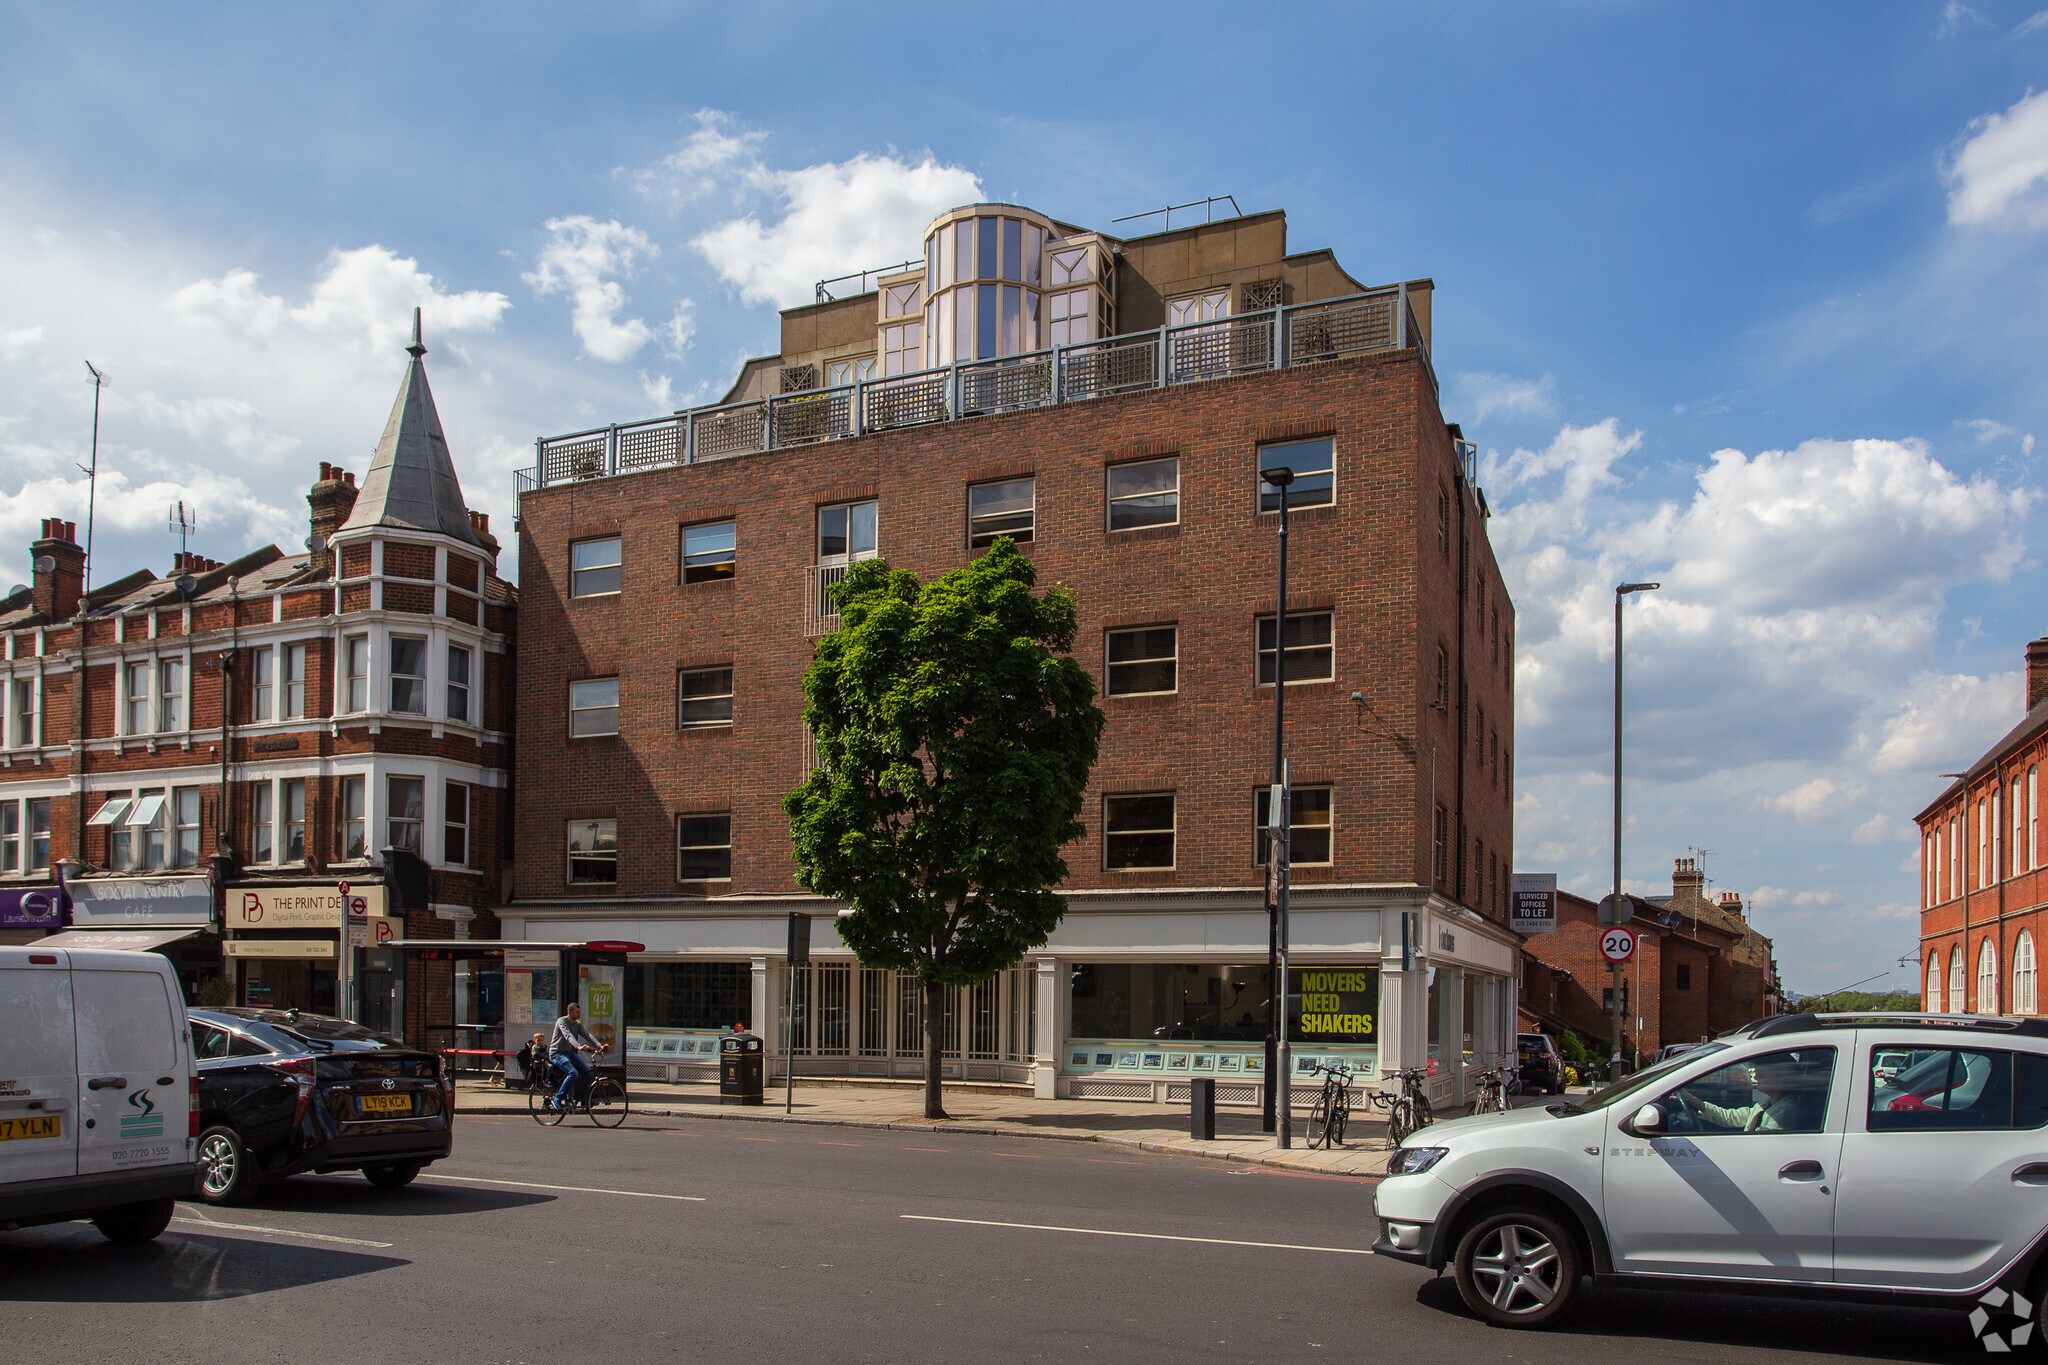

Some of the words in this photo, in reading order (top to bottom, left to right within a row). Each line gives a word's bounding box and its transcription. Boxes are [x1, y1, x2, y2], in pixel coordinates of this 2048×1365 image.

[98, 886, 137, 901] SOCIAL
[144, 884, 187, 899] PANTRY
[341, 882, 348, 892] A
[273, 897, 292, 910] THE
[295, 896, 325, 910] PRINT
[1519, 892, 1548, 900] SERVICED
[272, 912, 289, 922] Digital
[304, 912, 325, 922] Graphic
[1520, 908, 1531, 917] TO
[1532, 908, 1547, 917] LET
[1605, 937, 1632, 953] 20
[1302, 972, 1366, 992] MOVERS
[1302, 993, 1341, 1013] NEED
[1301, 1013, 1373, 1034] SHAKERS
[365, 1096, 387, 1109] LY19
[389, 1096, 408, 1108] KCK
[19, 1118, 53, 1136] YLN
[112, 1150, 128, 1160] 020
[130, 1148, 149, 1158] 7720
[152, 1146, 170, 1156] 1555
[1609, 1147, 1700, 1157] STEPWAY
